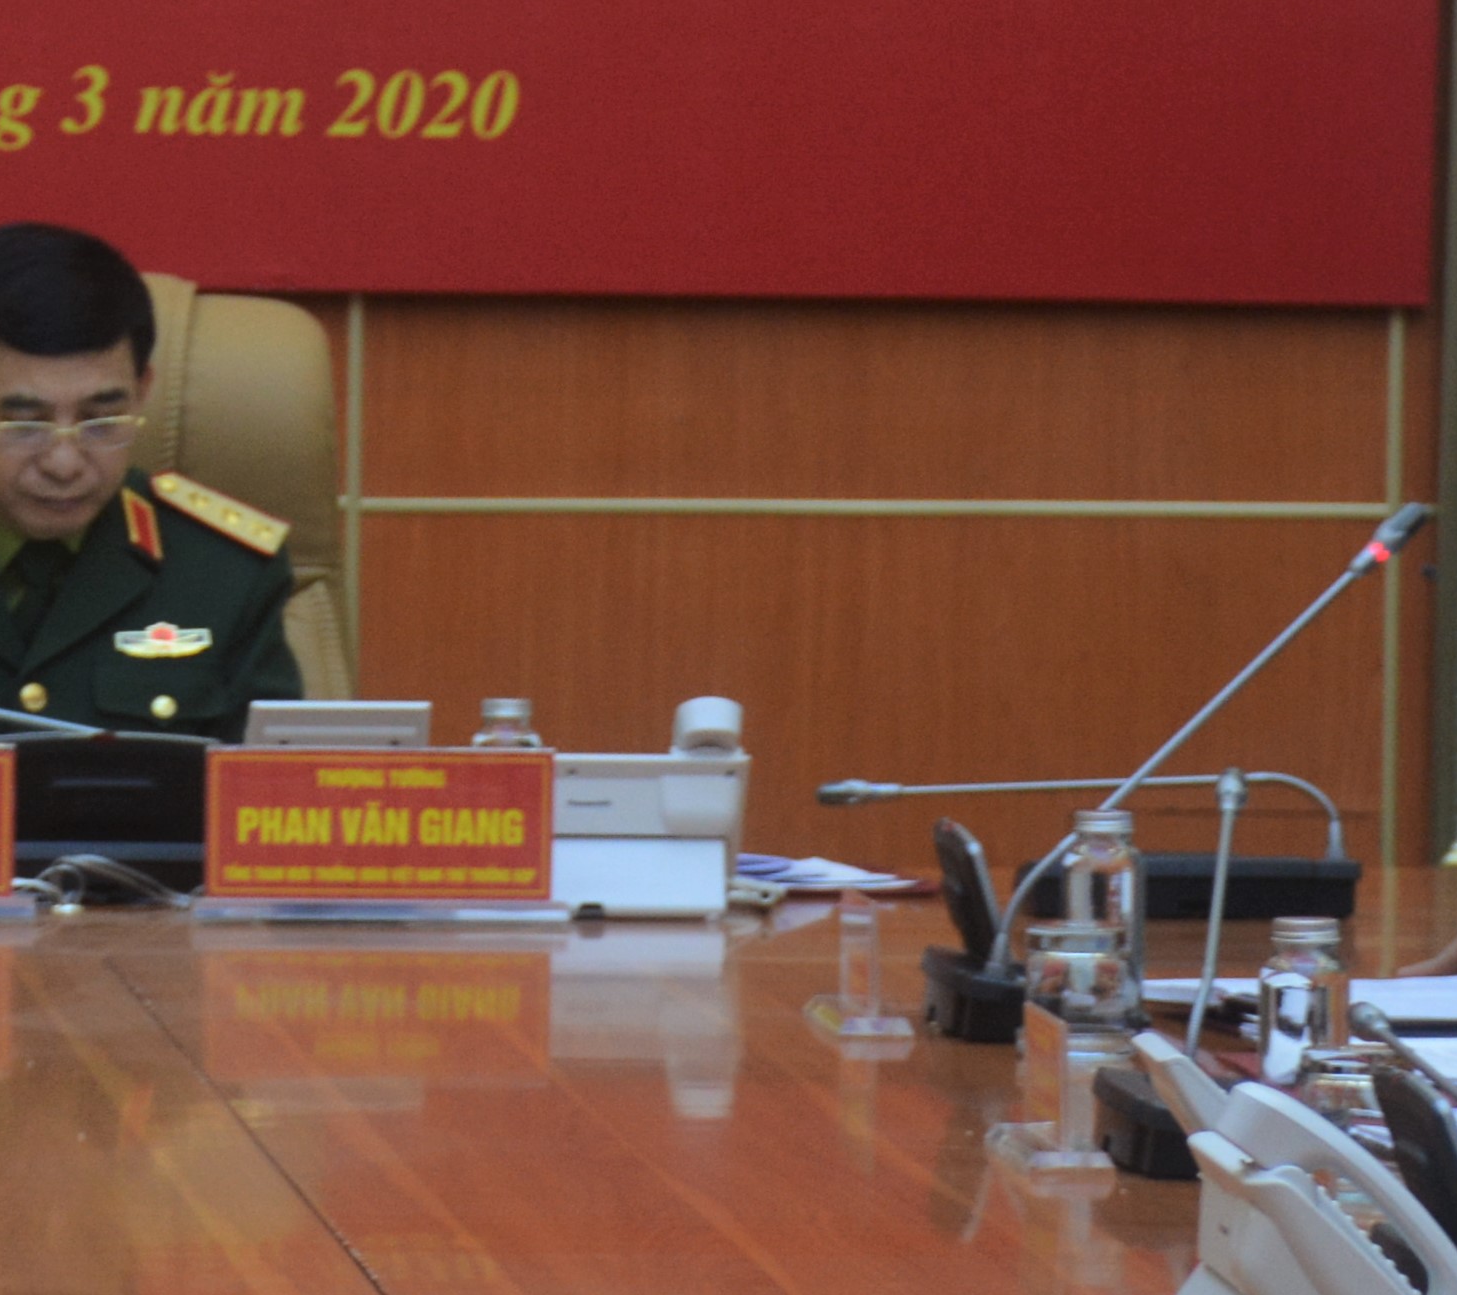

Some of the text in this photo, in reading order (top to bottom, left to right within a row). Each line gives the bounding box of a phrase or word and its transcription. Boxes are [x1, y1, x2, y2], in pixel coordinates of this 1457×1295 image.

[59, 64, 110, 135] 3
[135, 72, 305, 138] năm
[327, 68, 521, 139] 2020
[237, 801, 525, 846] PHAN VĂN GIANG
